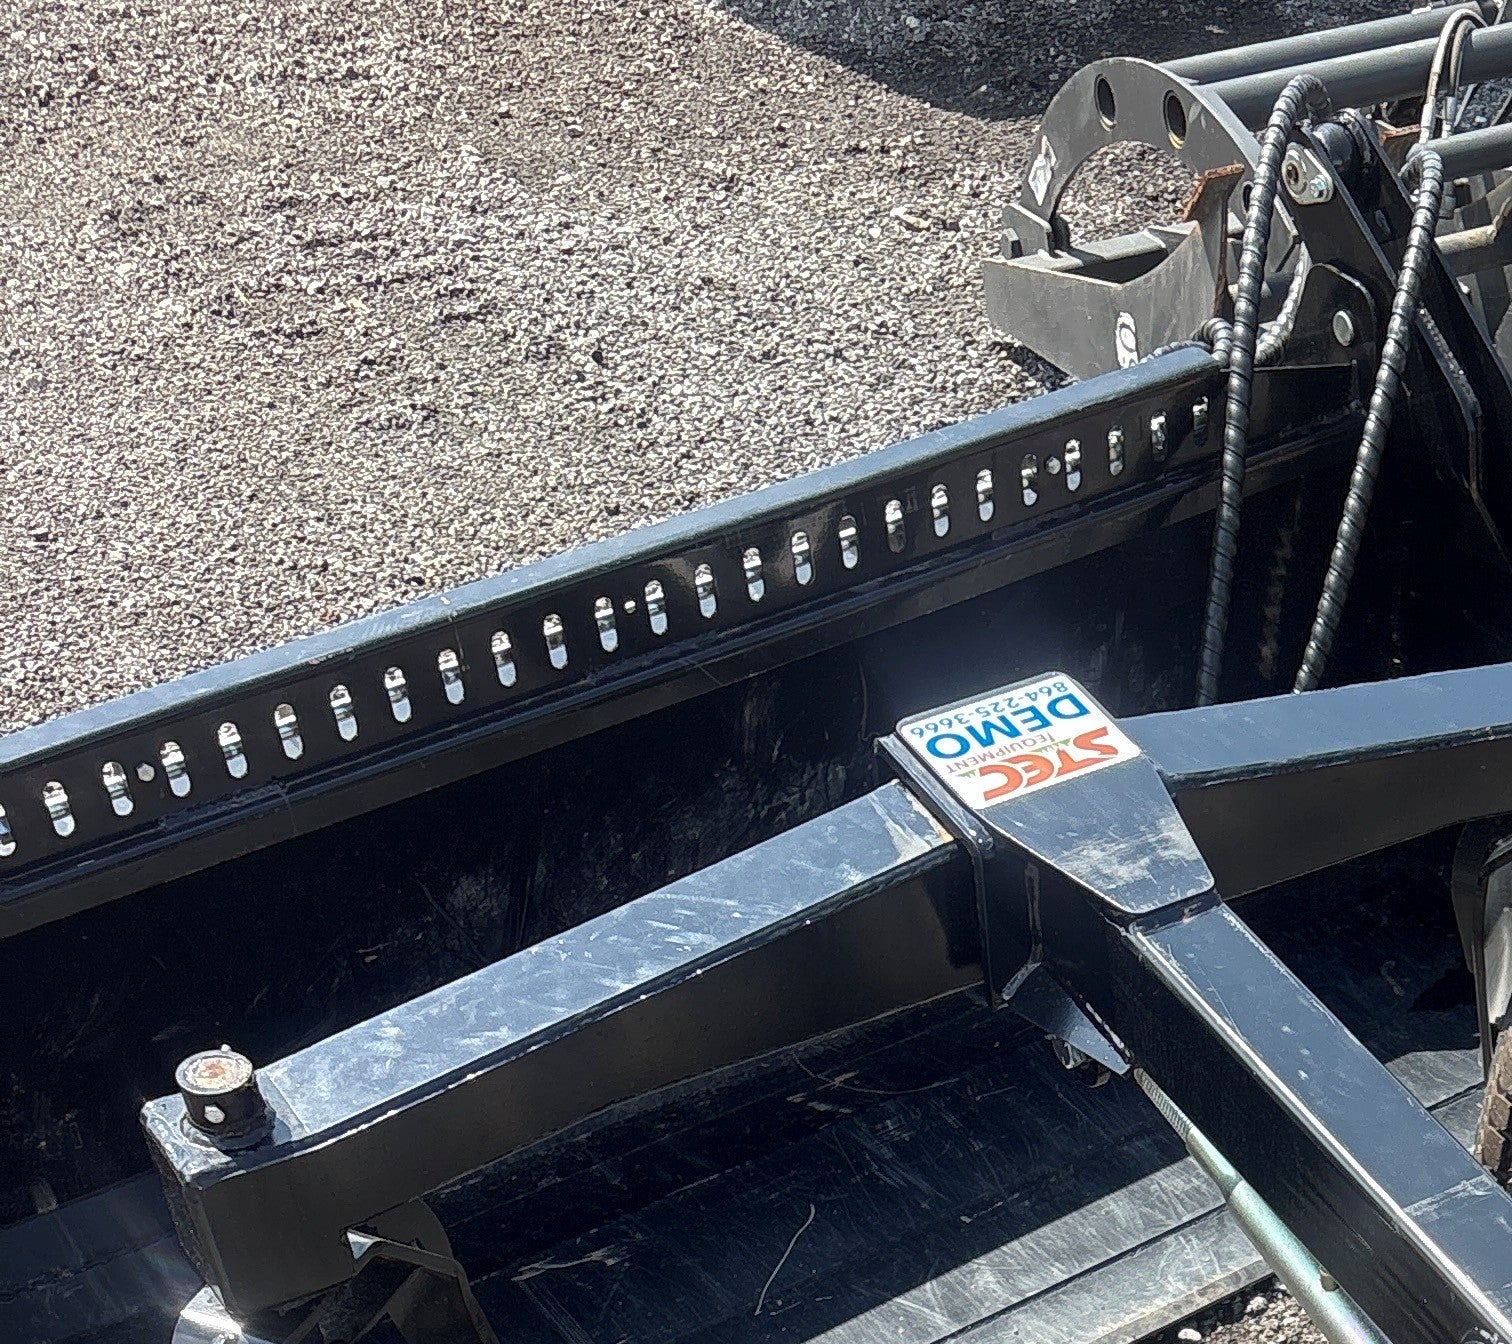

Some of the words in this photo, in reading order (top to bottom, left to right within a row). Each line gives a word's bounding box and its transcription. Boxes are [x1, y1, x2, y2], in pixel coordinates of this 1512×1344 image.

[911, 681, 1068, 739] 864-225-3666
[925, 692, 1091, 759] DEMO
[946, 733, 1051, 774] EQUIPMENT
[979, 726, 1119, 802] STEC
